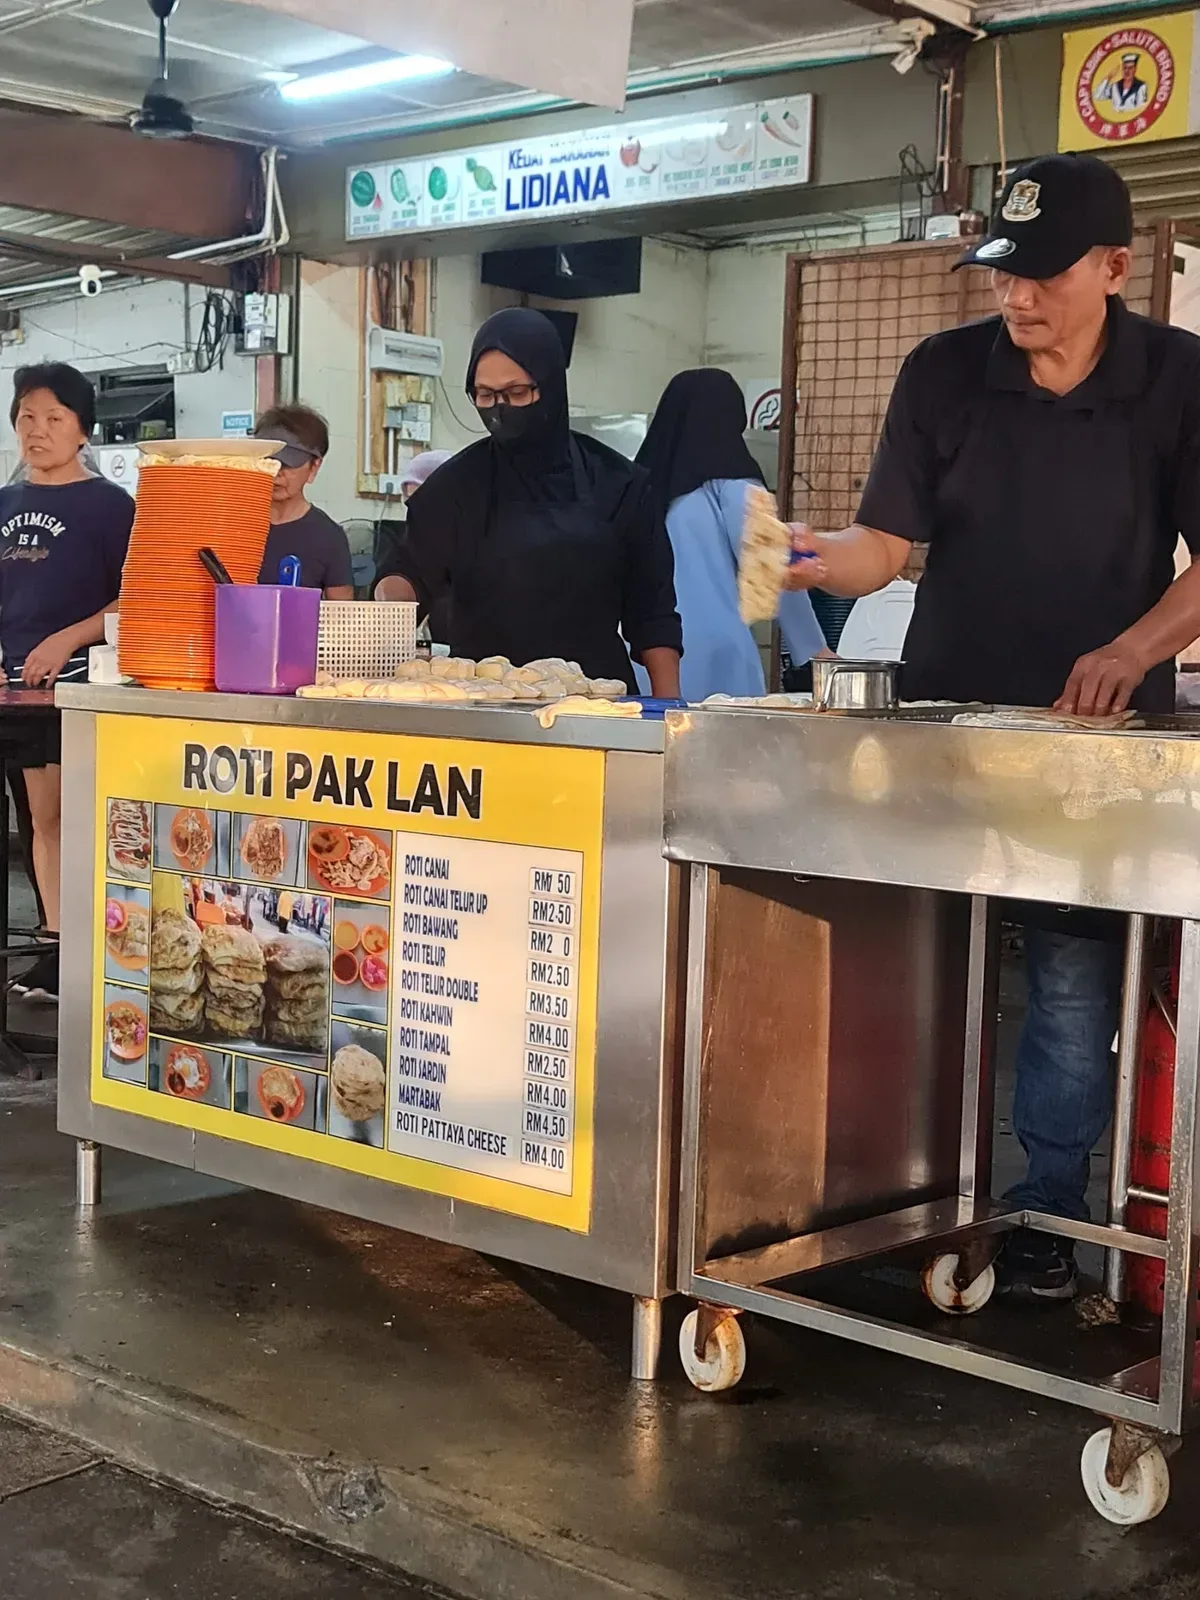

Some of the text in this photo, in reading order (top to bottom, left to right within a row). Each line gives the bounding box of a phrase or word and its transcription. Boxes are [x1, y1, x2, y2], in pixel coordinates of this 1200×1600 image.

[1078, 31, 1173, 117] CAP TABIK SALUTE BRAND
[505, 164, 610, 211] LIDIANA
[1, 512, 66, 537] OPTIMISM
[18, 534, 38, 546] IS A
[183, 744, 482, 819] ROTI PAK LAN
[405, 854, 450, 880] ROTI CANAI
[404, 884, 488, 914] ROTI CANAI TELUR UP
[403, 912, 458, 940] ROTI BAWANG
[402, 941, 446, 967] ROTI TELUR
[402, 970, 478, 1002] ROTI TELUR DOUBLE
[531, 962, 569, 986] RM2.50
[400, 998, 453, 1027] ROTI KAHWIN
[530, 992, 568, 1018] RM3.50
[400, 1026, 450, 1056] ROTI TAMPAL
[530, 1023, 568, 1048] RM4.00
[399, 1055, 446, 1084] ROTI SARDIN
[528, 1052, 566, 1078] RM2.50
[398, 1084, 441, 1112] MARTABAK
[528, 1082, 566, 1108] RM4.00
[396, 1112, 507, 1156] ROTI PATTAYA CHEESE
[526, 1112, 565, 1137] RM4.50
[525, 1143, 564, 1169] RM4.00
